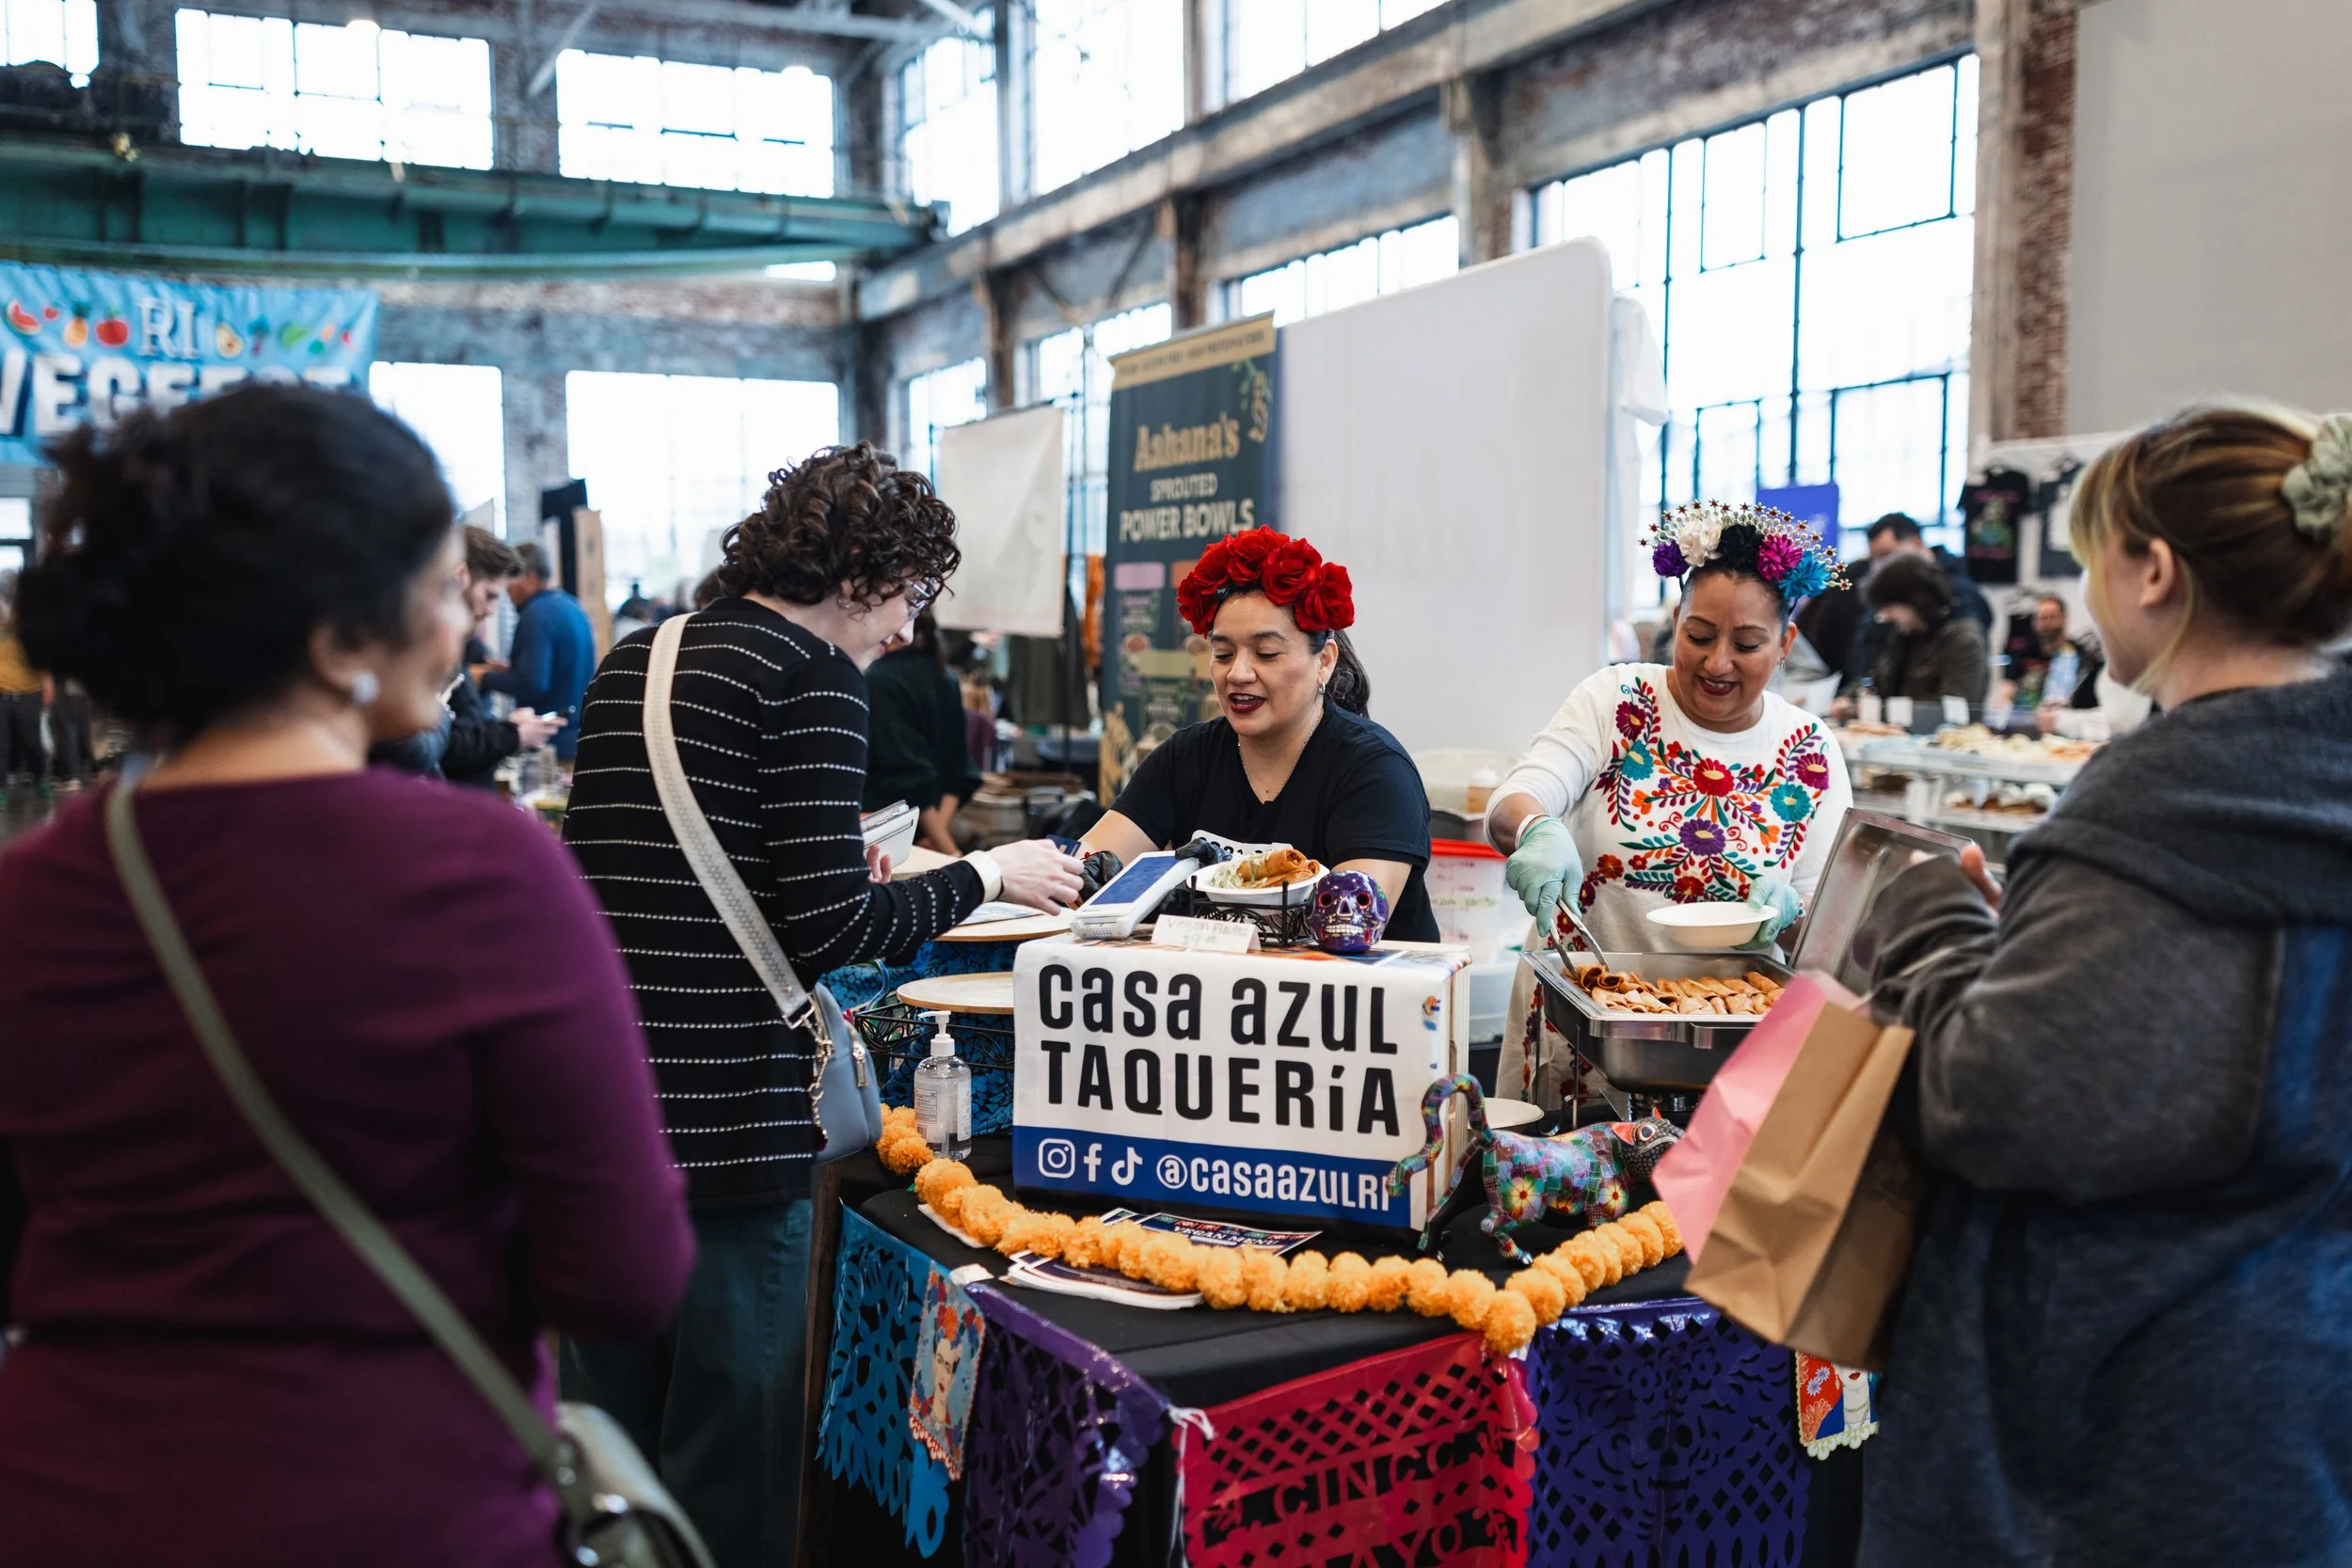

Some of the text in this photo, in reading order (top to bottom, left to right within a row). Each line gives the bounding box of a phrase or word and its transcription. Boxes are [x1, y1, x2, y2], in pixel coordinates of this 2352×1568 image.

[137, 296, 199, 359] RI
[1149, 472, 1218, 502] SPROUTED
[1119, 498, 1256, 543] POWER BOWLS
[1174, 1226, 1226, 1241] VEGAN
[1273, 1436, 1456, 1518] CINCO
